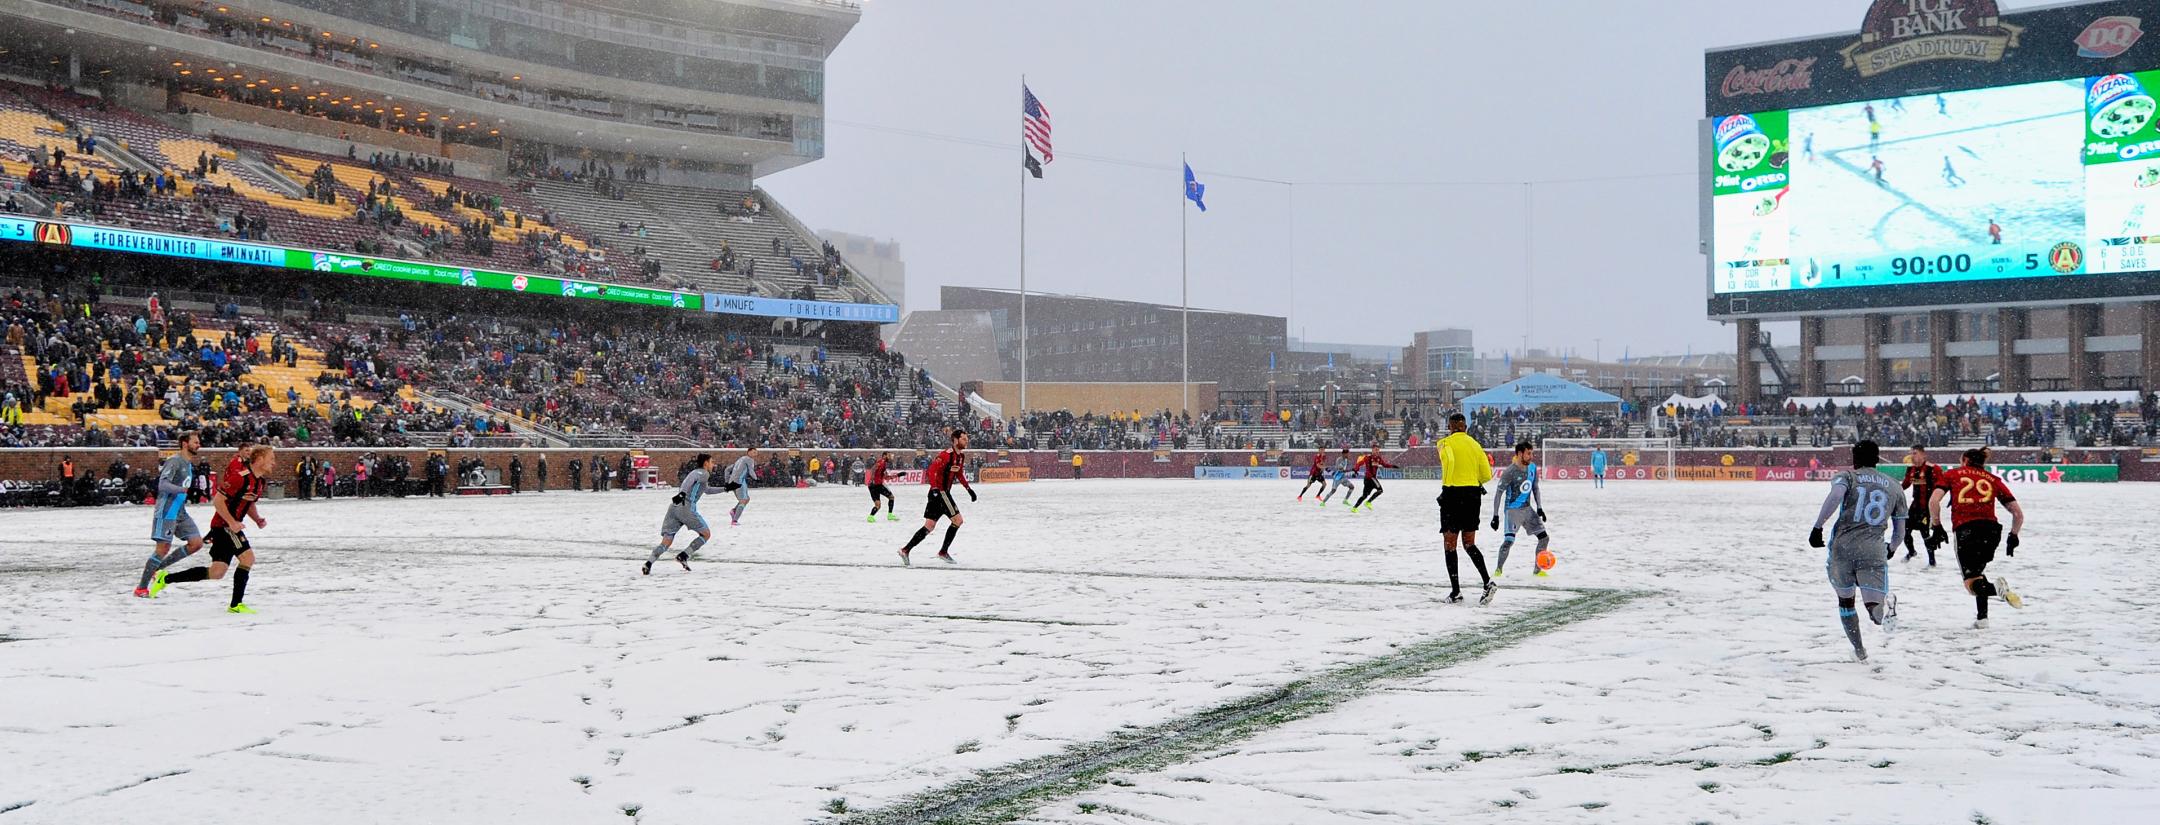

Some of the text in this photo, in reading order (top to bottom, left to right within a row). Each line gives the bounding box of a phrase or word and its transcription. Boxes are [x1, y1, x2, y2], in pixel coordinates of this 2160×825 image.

[1891, 8, 1967, 38] BANK
[2087, 25, 2133, 47] DQ
[1871, 39, 1990, 70] STADIUM
[1721, 57, 1817, 97] Coca-Cola
[2120, 139, 2160, 159] ORE
[1741, 173, 1786, 190] OREO
[17, 224, 25, 236] 5
[93, 231, 196, 255] #FOREVERUNITED
[1891, 253, 1971, 276] 90:00
[2025, 253, 2038, 270] 5
[2121, 258, 2147, 269] SAVES
[1832, 263, 1841, 280] 1
[723, 298, 754, 311] MNUFC
[789, 303, 841, 317] FOREVER
[1729, 470, 1753, 479] TIRE
[1765, 469, 1796, 480] Audi
[1857, 474, 1890, 489] MOLINO
[1957, 476, 1993, 504] 29
[1853, 486, 1889, 526] 18
